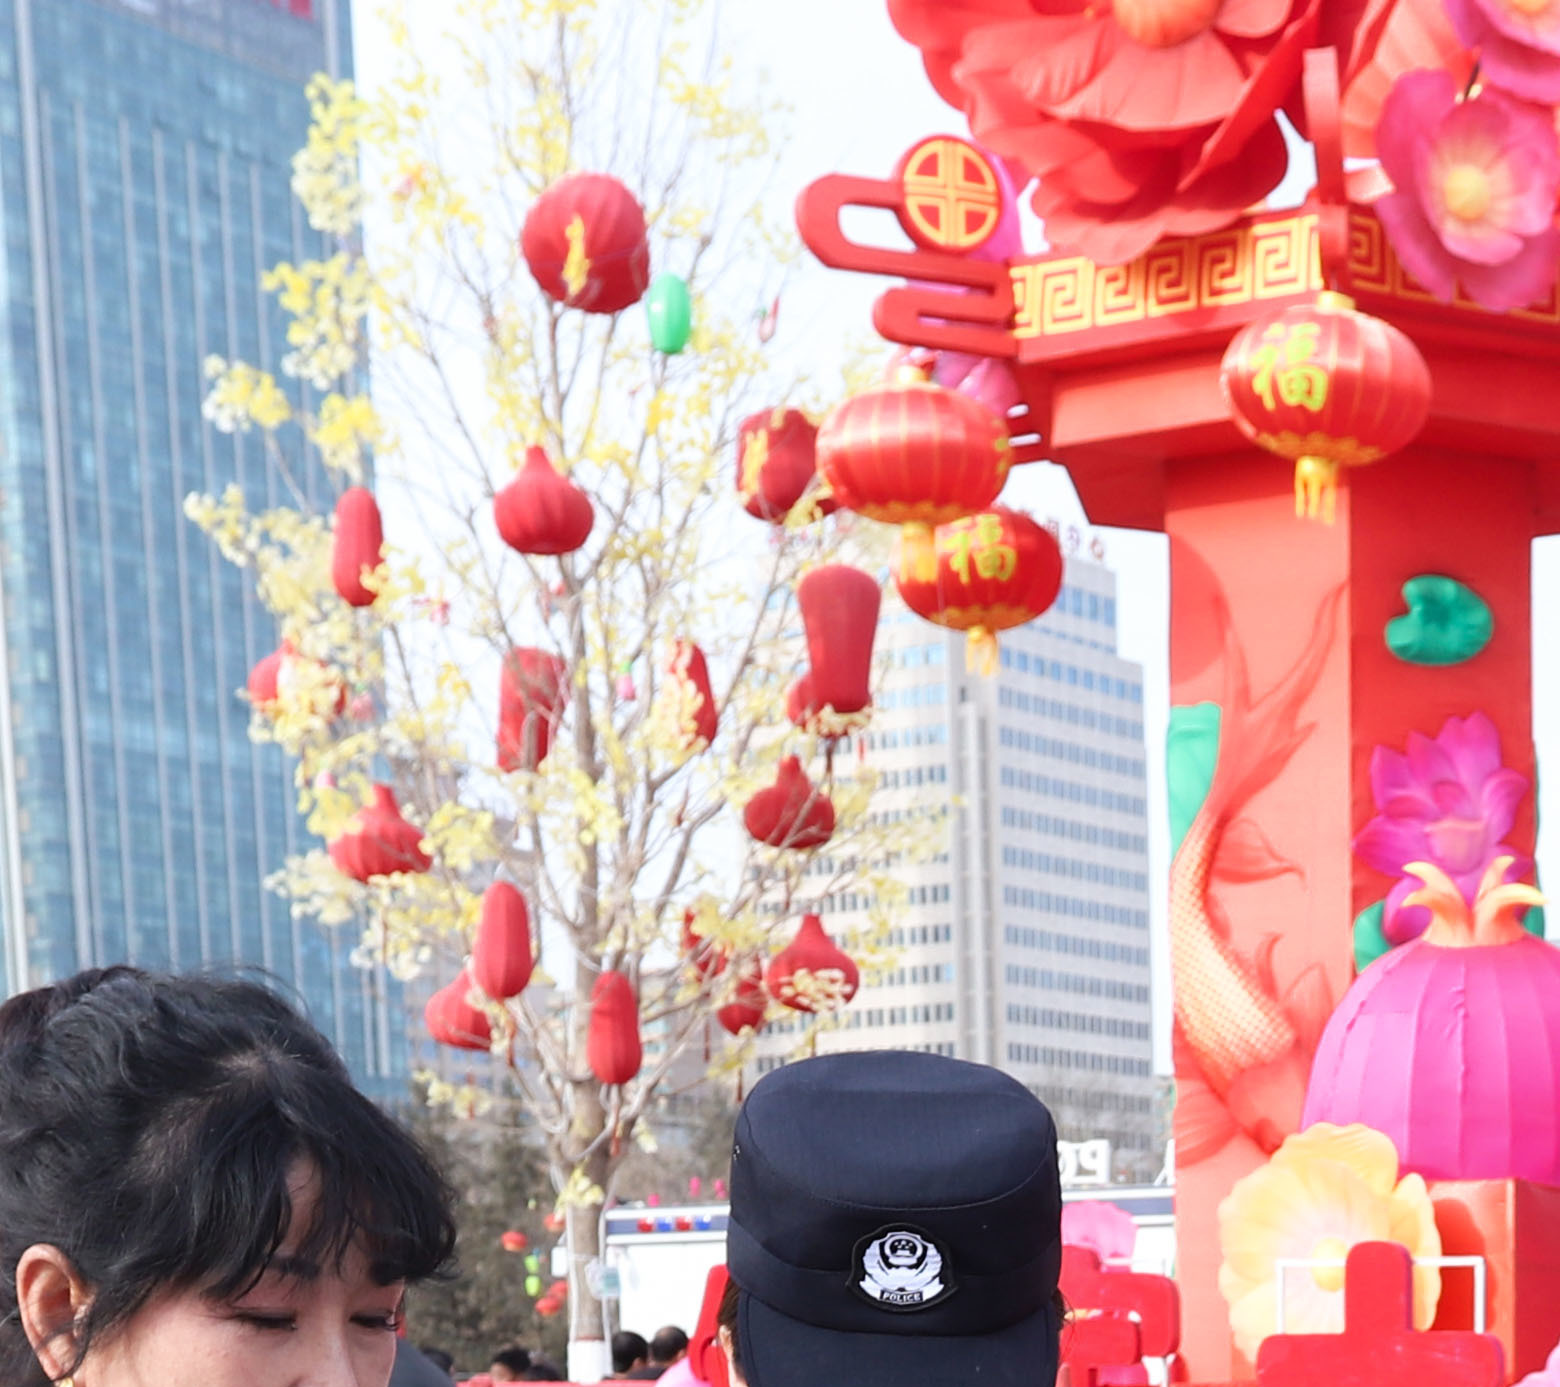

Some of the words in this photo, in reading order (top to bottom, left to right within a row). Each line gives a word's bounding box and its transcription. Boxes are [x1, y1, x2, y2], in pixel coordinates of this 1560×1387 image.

[1250, 322, 1329, 412] 福
[944, 514, 1017, 585] 福
[883, 1291, 921, 1302] POLICE
